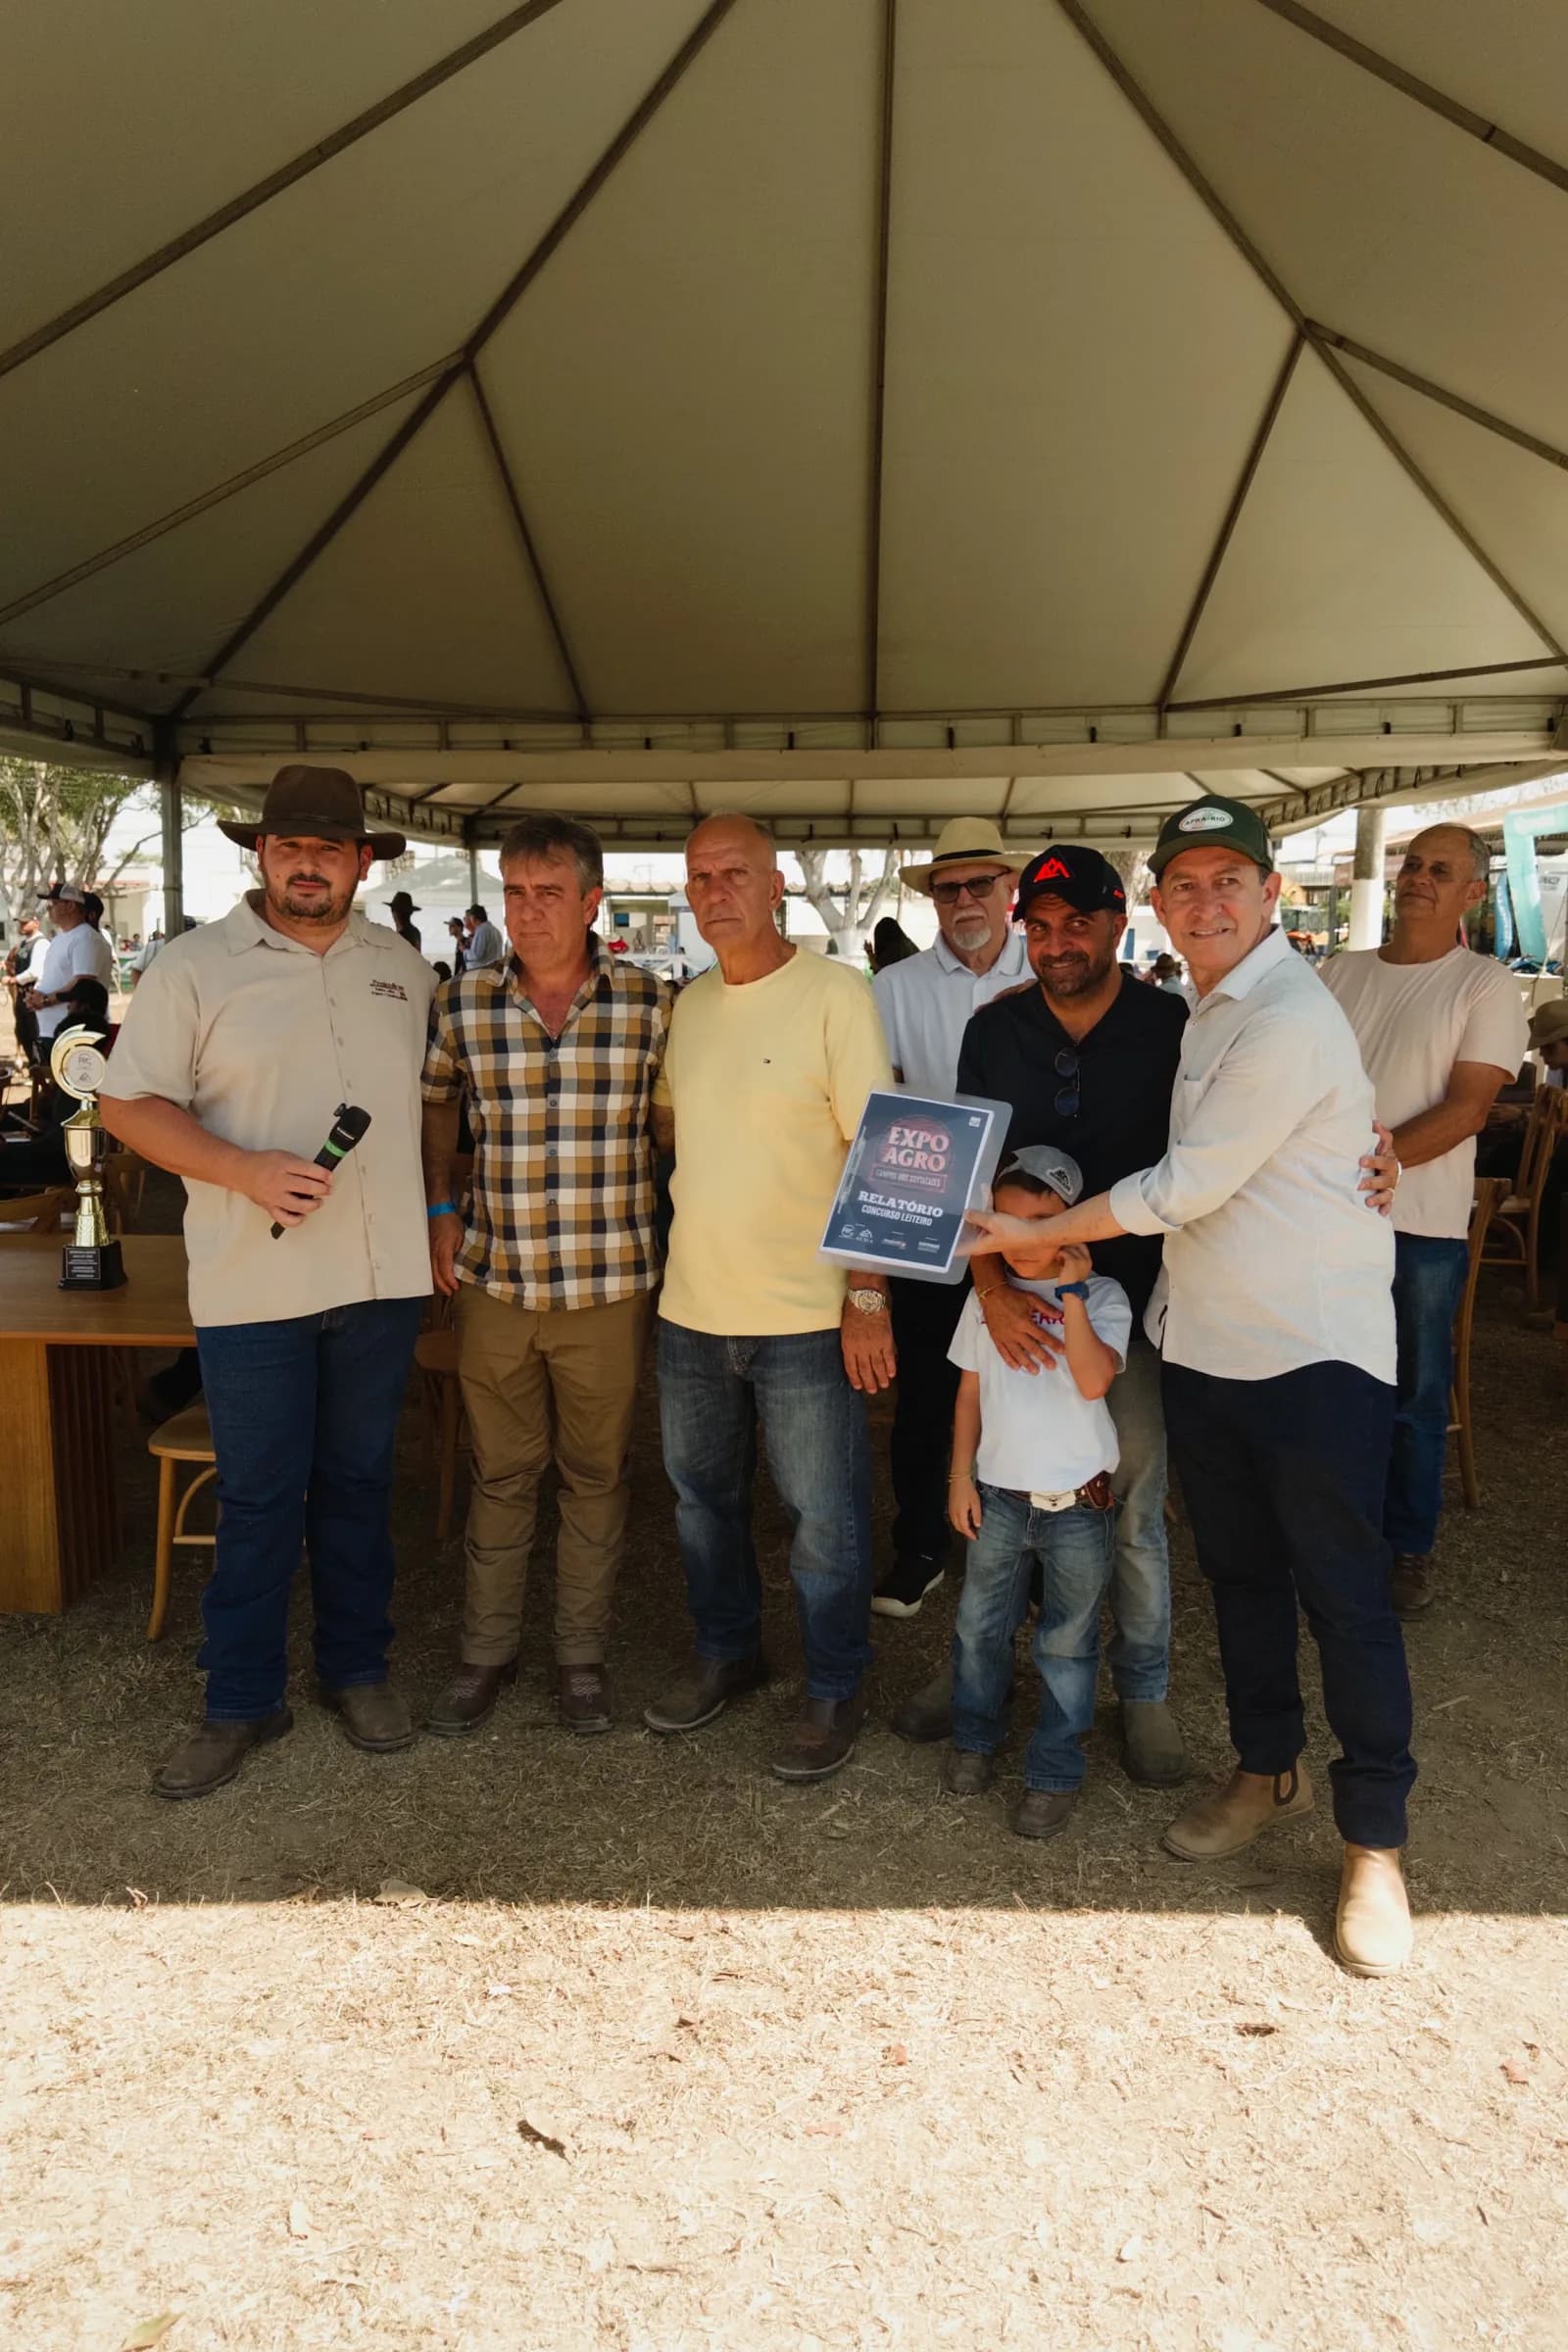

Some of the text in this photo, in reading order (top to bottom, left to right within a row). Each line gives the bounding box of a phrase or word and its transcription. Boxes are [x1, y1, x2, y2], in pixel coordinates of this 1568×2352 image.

[888, 1126, 950, 1152] EXPO
[883, 1147, 946, 1172] AGRO
[858, 1190, 944, 1217] RELATÓRIO
[861, 1204, 933, 1226] CONCURSO LEITEIRO
